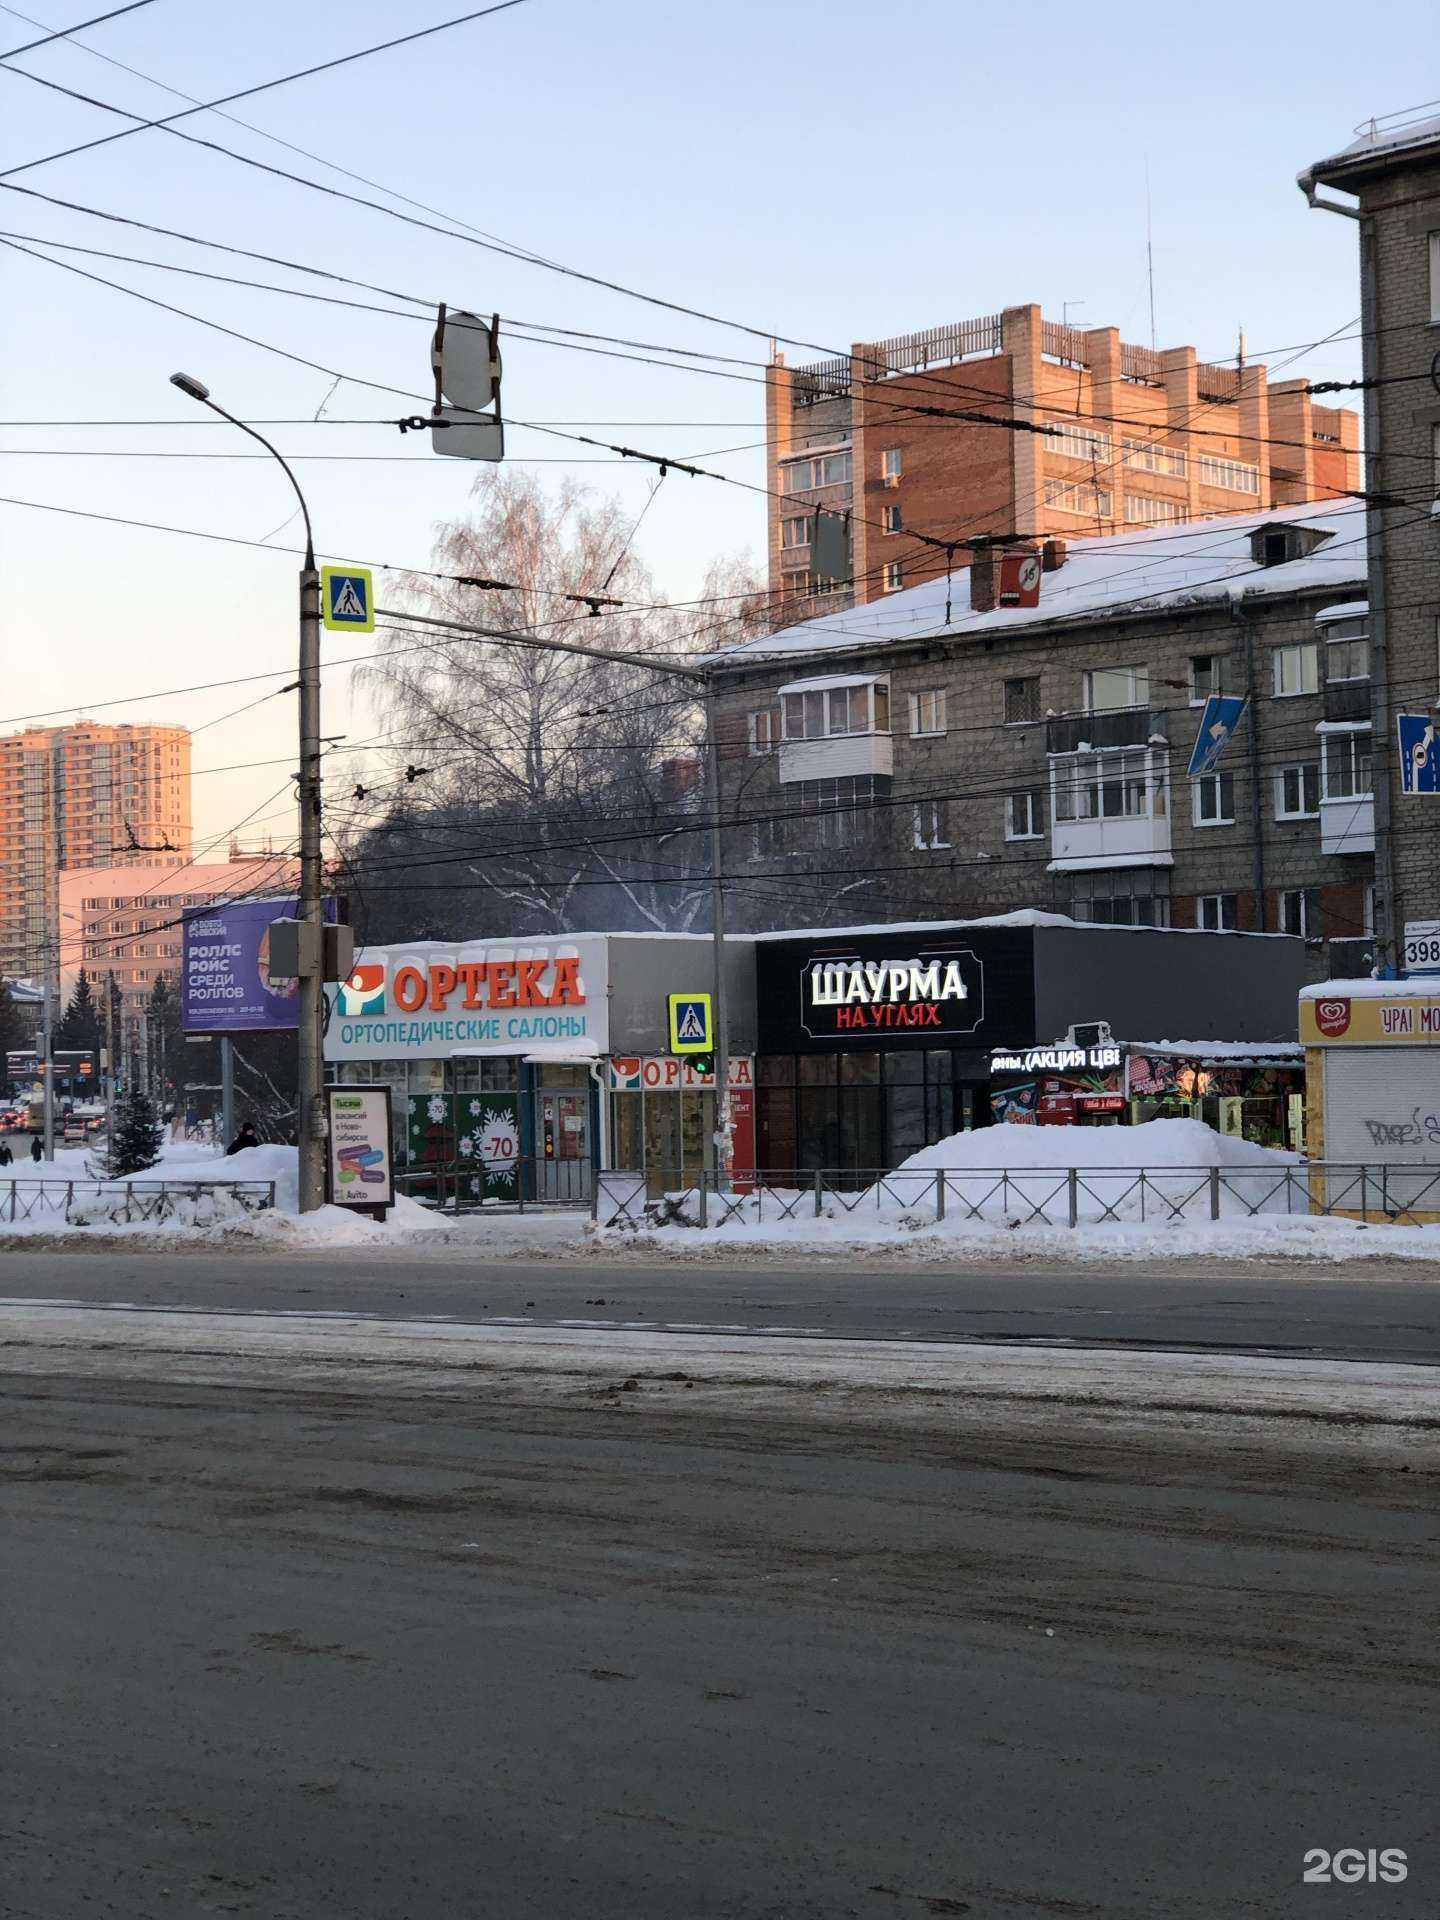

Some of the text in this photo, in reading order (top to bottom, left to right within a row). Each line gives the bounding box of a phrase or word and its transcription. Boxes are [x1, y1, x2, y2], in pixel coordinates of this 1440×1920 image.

[188, 944, 242, 958] РОЛЛС
[188, 957, 230, 972] РОЙС
[188, 974, 235, 987] СРЕДИ
[393, 957, 587, 1013] ОРТЕКА
[811, 965, 968, 1006] ШАУРМА
[188, 987, 245, 999] РОЛЛОВ
[836, 1003, 943, 1029] НА УГЛЯХ
[341, 1015, 586, 1046] ОРТОПЕДИЧЕСКИЕ САЛОНЫ
[643, 1060, 753, 1086] ОРТА
[484, 1136, 514, 1158] -70
[346, 1190, 368, 1200] Avito
